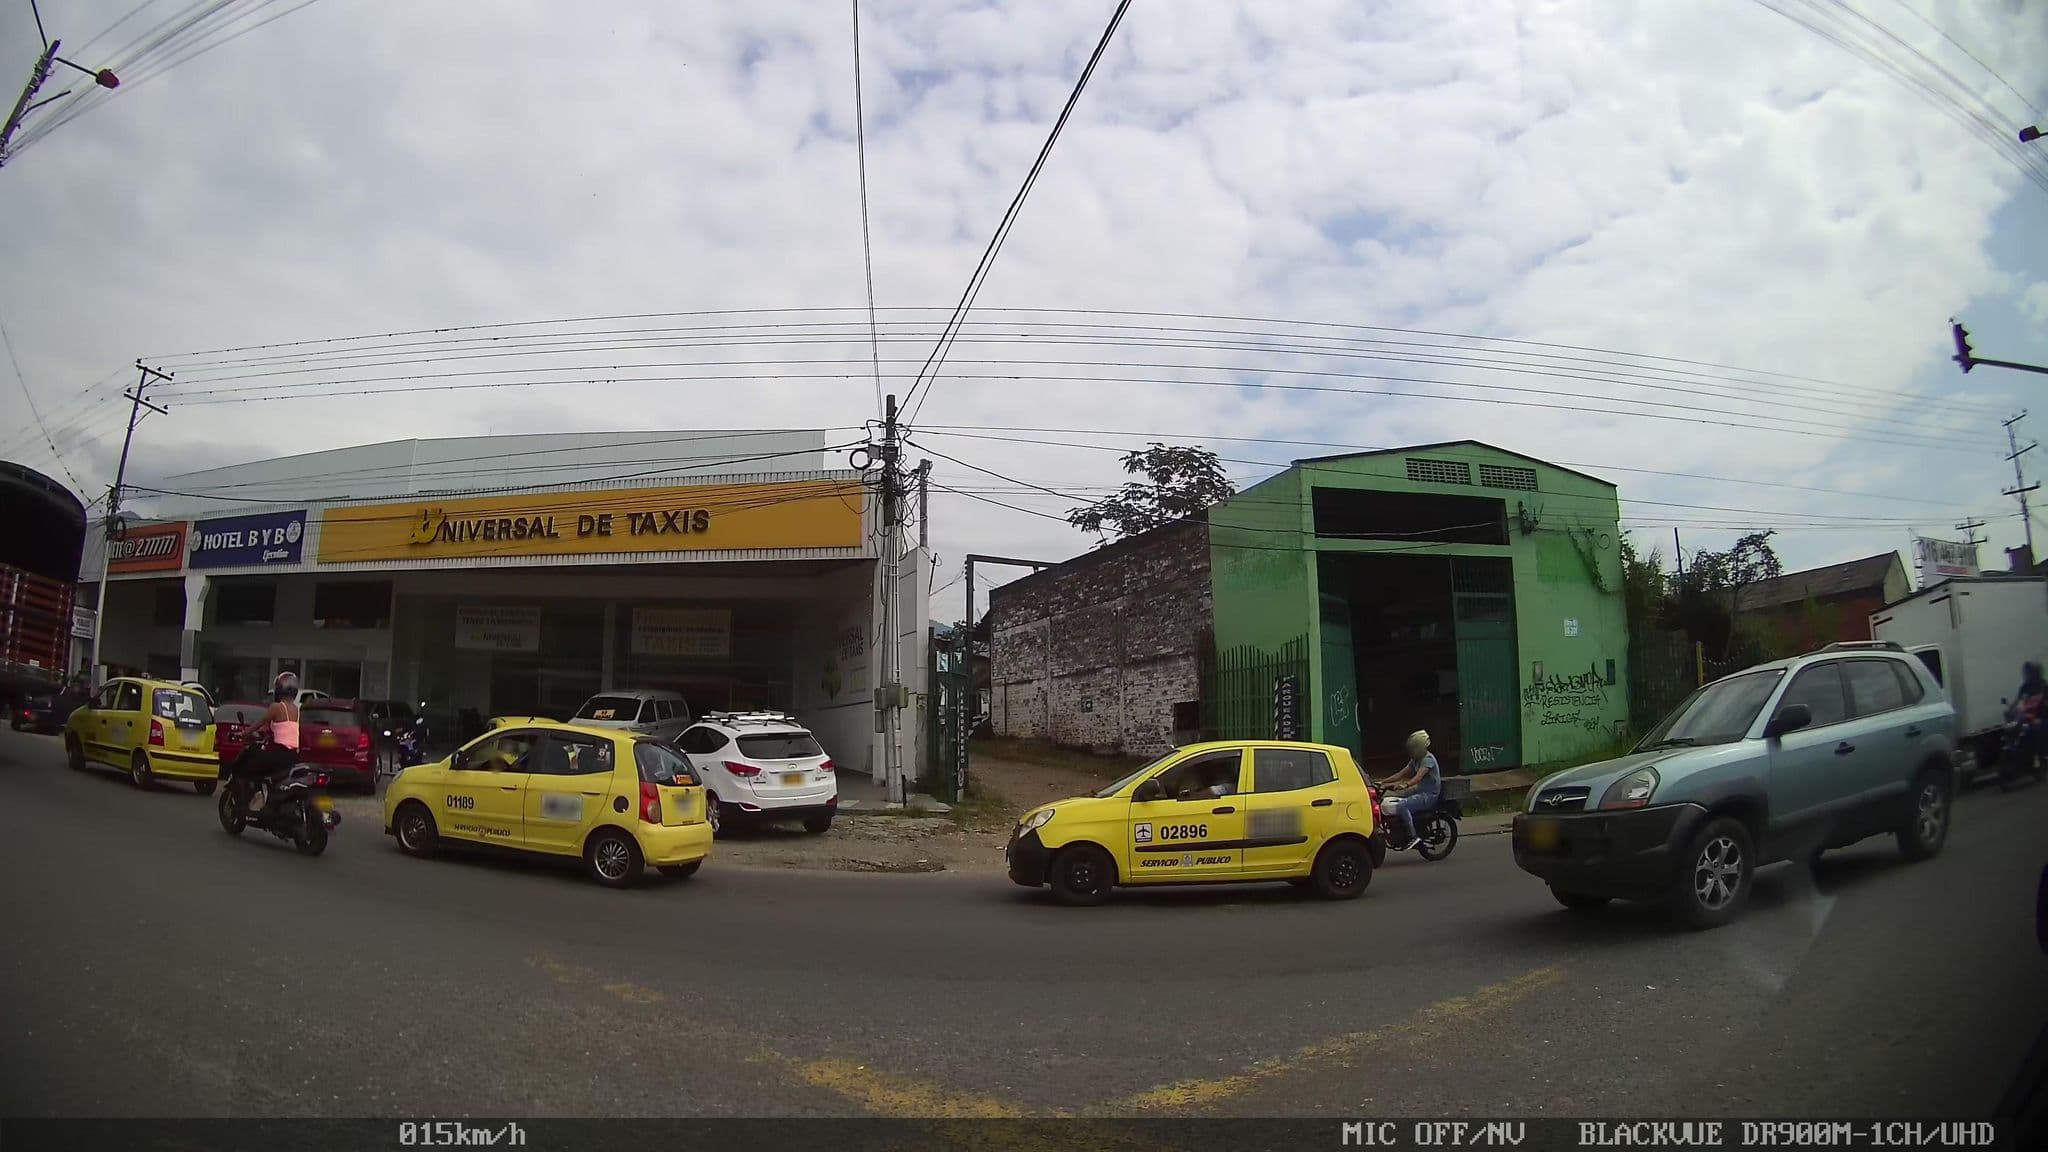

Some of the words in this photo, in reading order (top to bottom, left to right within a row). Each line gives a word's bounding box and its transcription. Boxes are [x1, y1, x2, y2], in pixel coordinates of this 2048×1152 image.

[408, 508, 559, 544] UNIVERSAL
[577, 513, 613, 537] DE
[626, 508, 710, 536] TAXIS
[203, 532, 244, 551] HOTEL
[248, 530, 259, 547] B
[262, 529, 272, 546] Y
[274, 528, 285, 545] B
[1281, 676, 1292, 739] PARQUEADER
[447, 795, 474, 810] 01189
[1160, 824, 1207, 840] 02896
[1140, 859, 1179, 868] SERVICIO
[1195, 856, 1232, 866] PUBLICO
